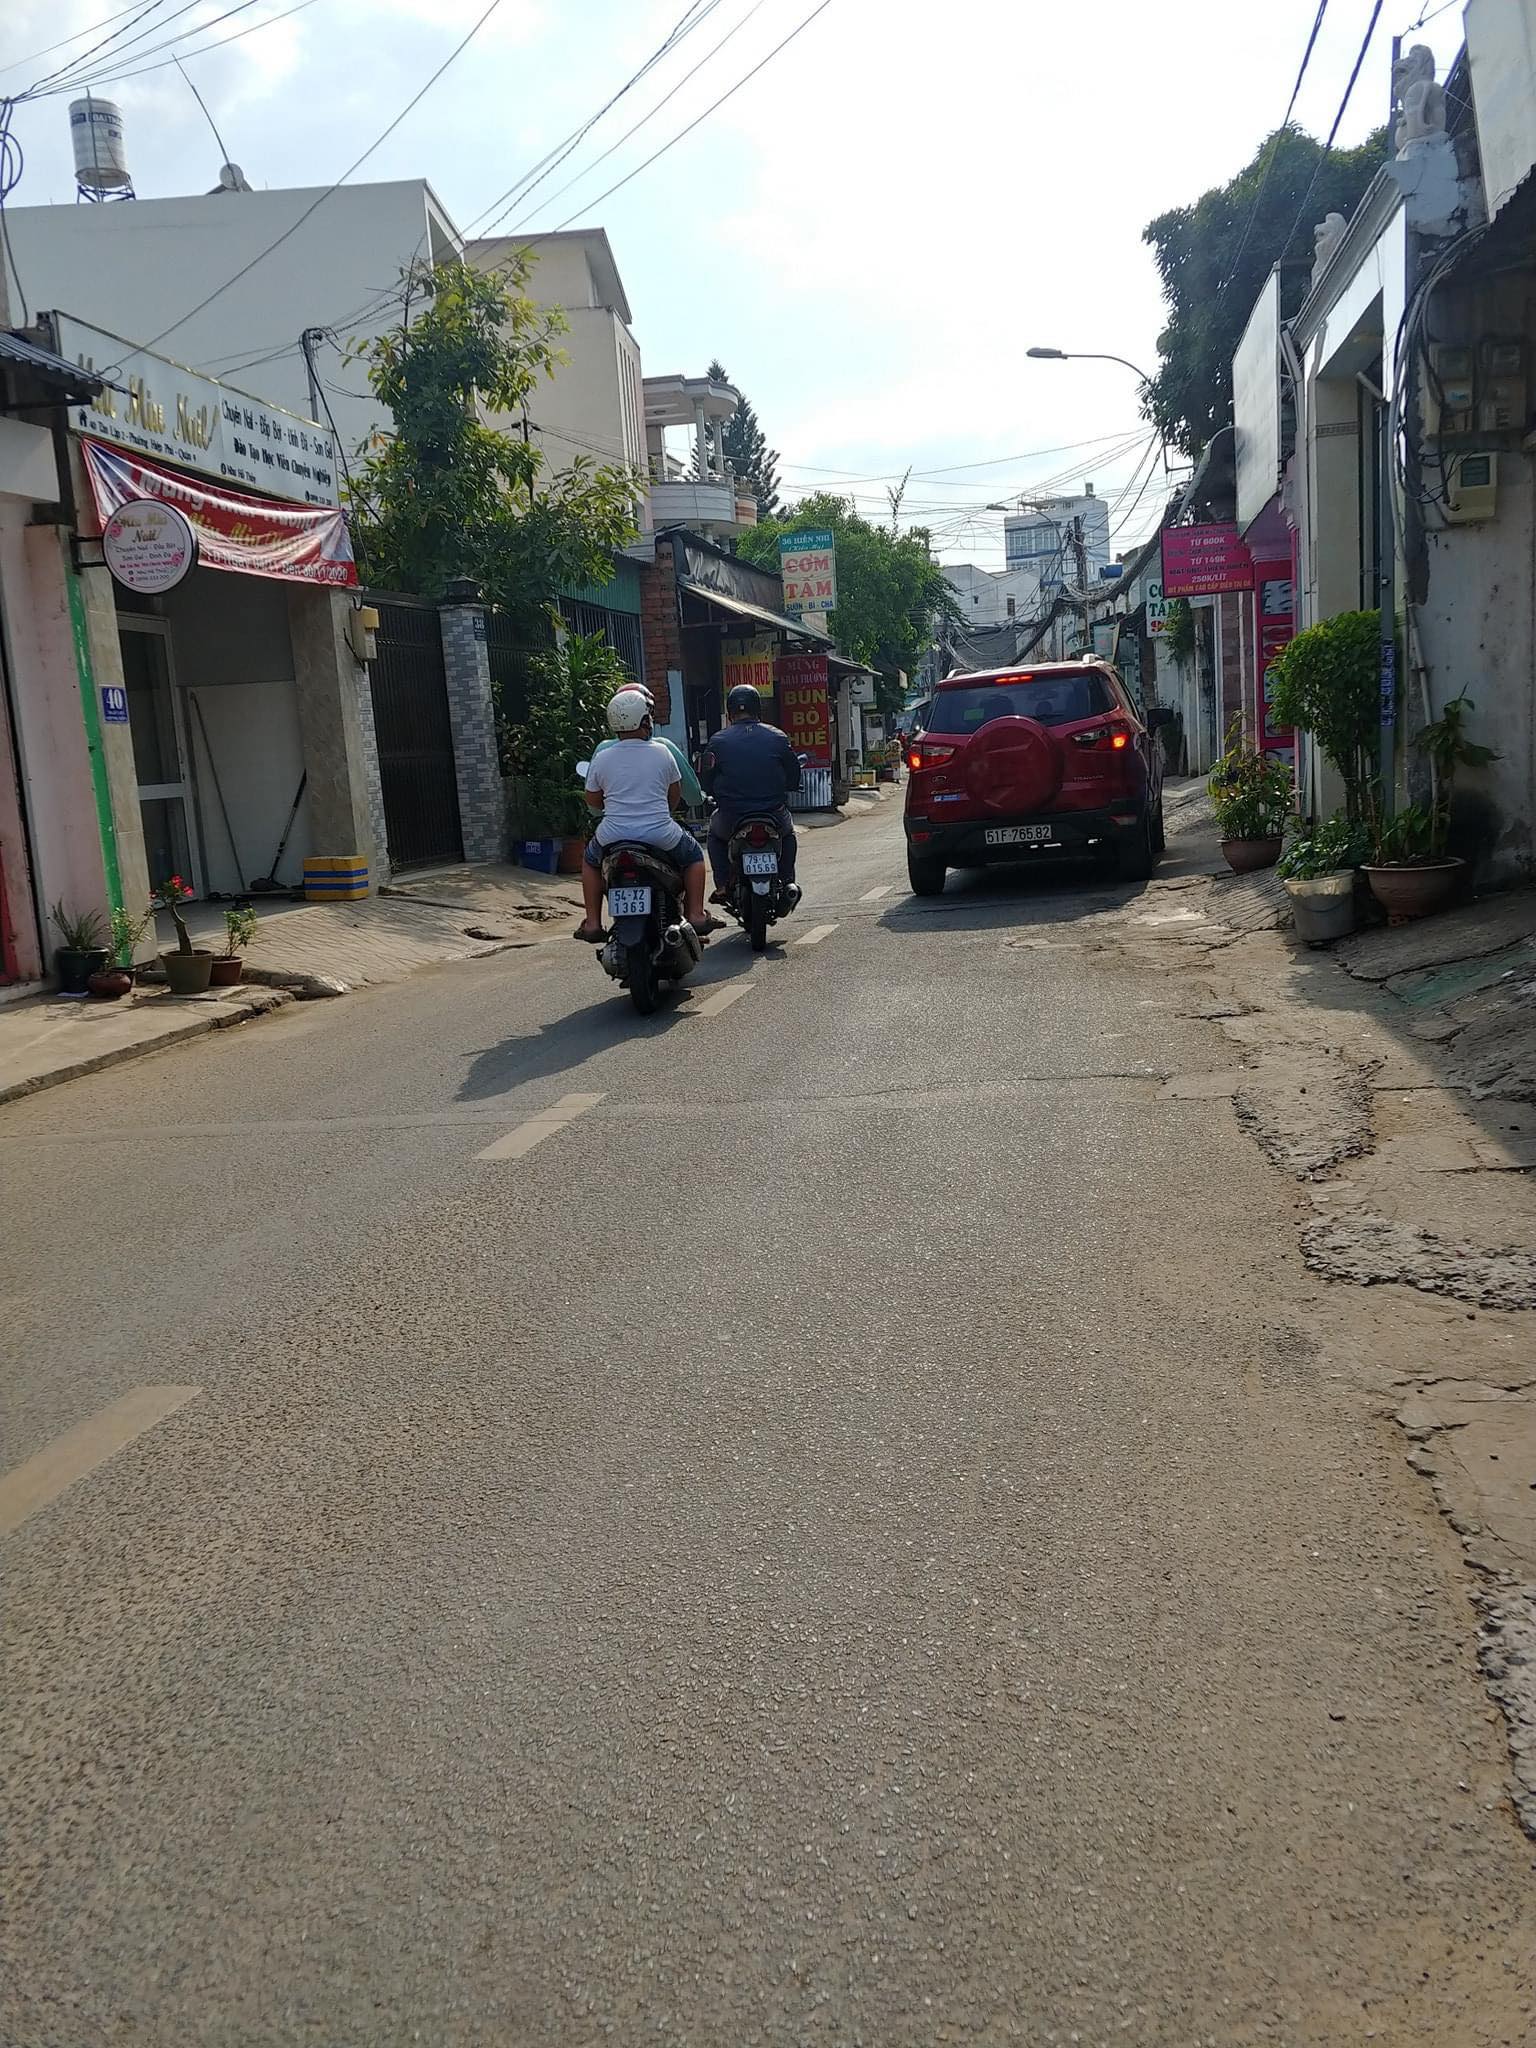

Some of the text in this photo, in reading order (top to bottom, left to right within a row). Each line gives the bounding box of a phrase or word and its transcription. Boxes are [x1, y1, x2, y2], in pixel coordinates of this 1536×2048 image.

[785, 554, 830, 573] CƠM
[784, 686, 827, 705] BÚN
[792, 706, 820, 725] BÒ
[986, 826, 1050, 843] 51F-765.82
[614, 889, 645, 901] 54-X2
[614, 901, 645, 914] 1363
